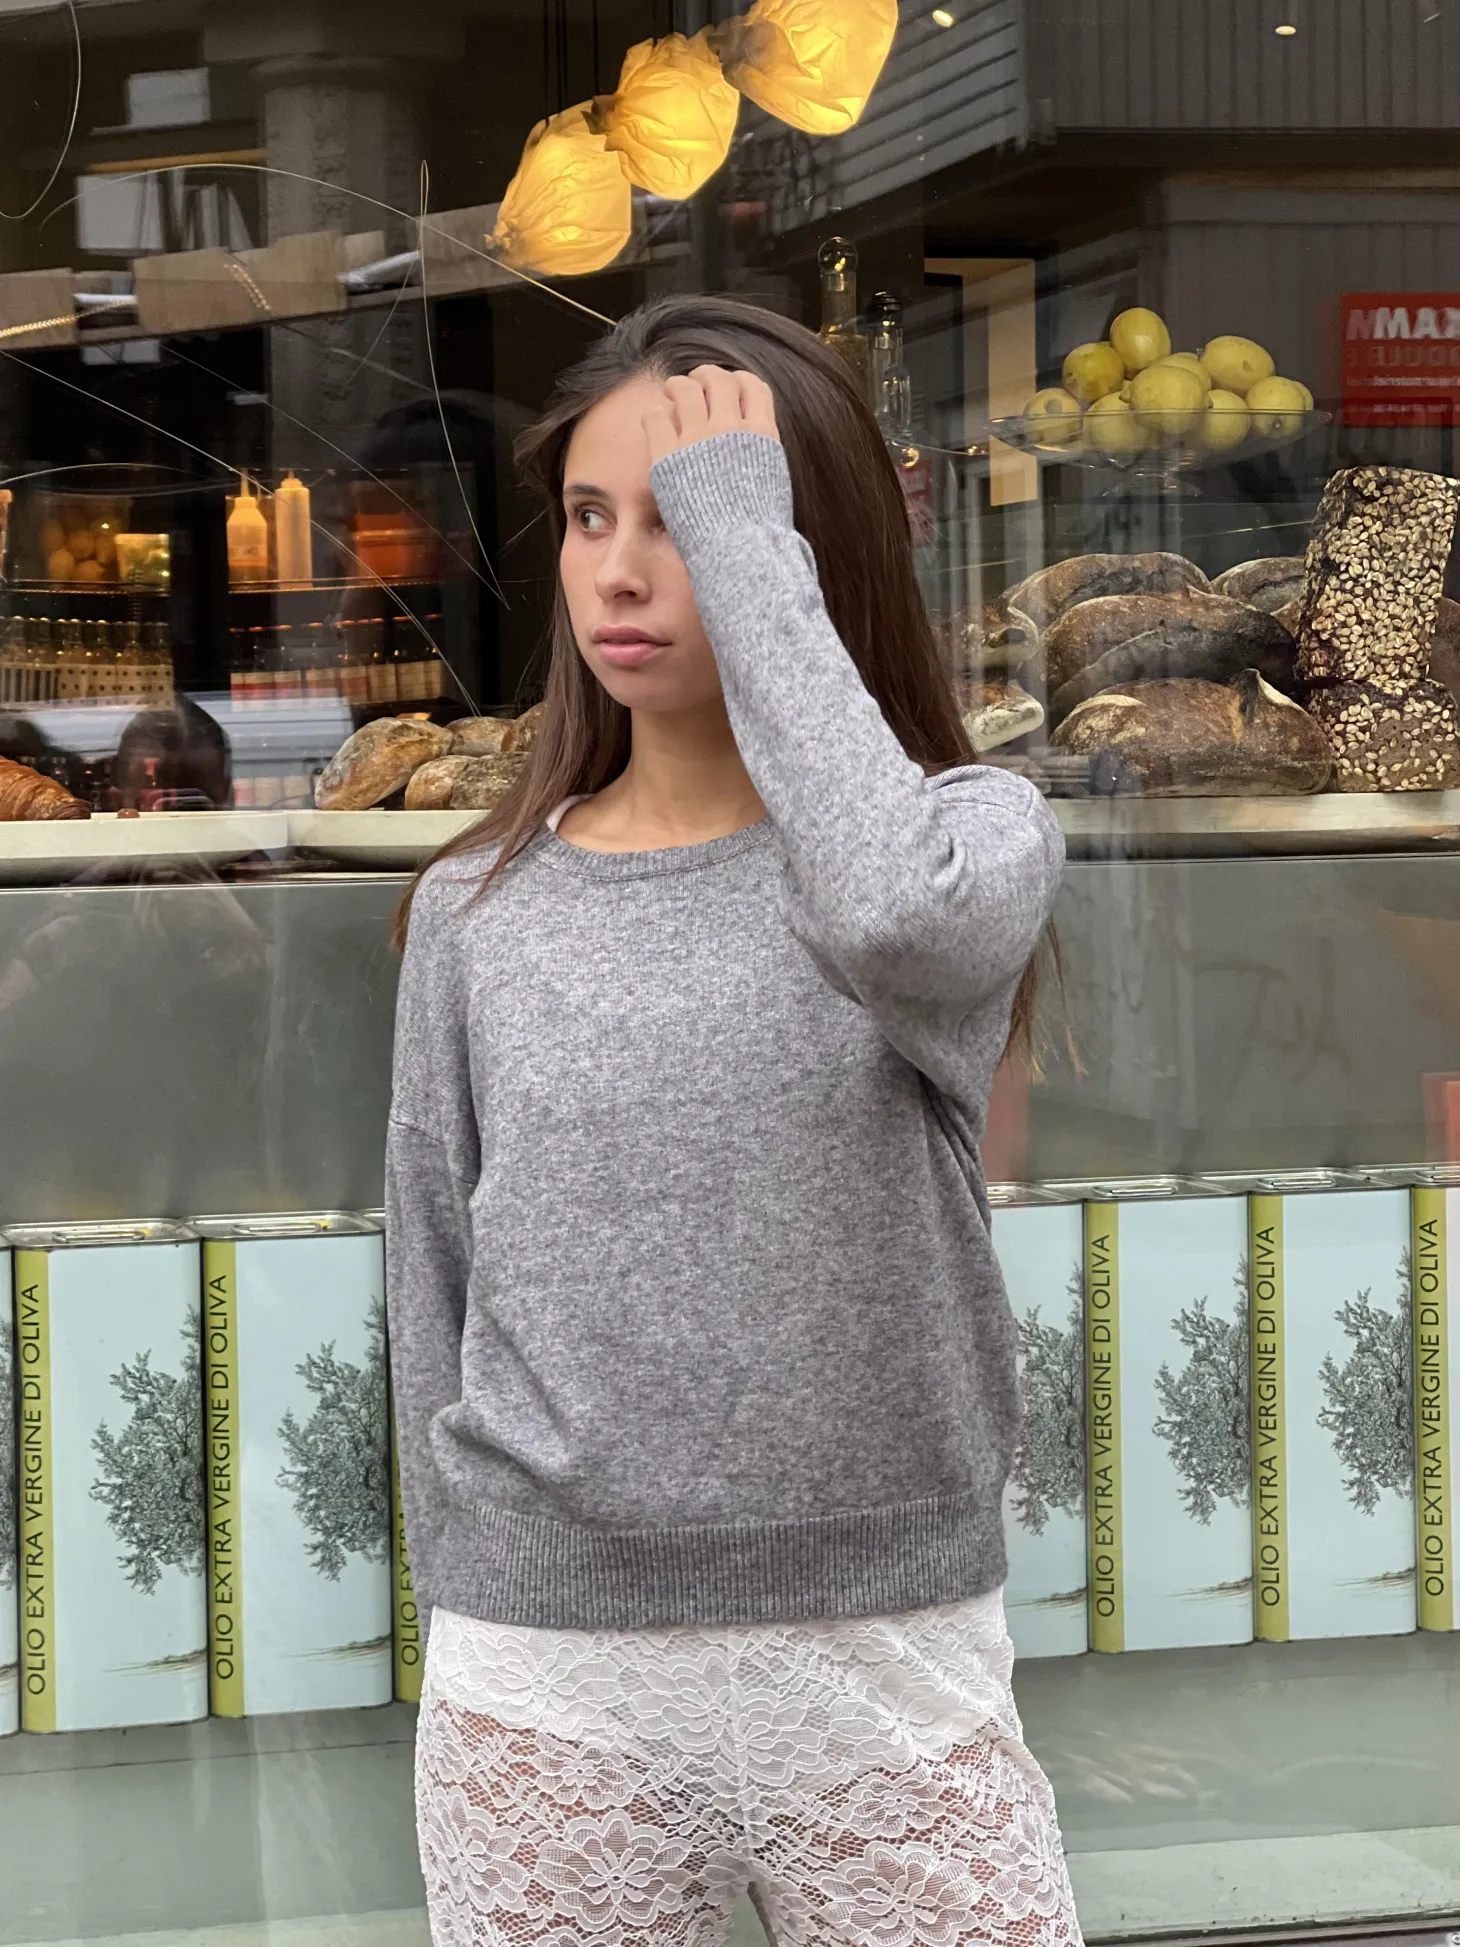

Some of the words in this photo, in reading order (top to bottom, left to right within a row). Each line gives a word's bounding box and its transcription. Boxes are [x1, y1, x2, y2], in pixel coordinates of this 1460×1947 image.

[1091, 1234, 1110, 1310] OLIVA
[1256, 1226, 1275, 1301] OLIVA
[1419, 1219, 1439, 1293] OLIVA
[21, 1284, 41, 1364] OLIVA
[209, 1275, 227, 1354] OLIVA
[1092, 1318, 1111, 1344] DI
[1257, 1310, 1275, 1334] DI
[1420, 1301, 1440, 1326] DI
[23, 1374, 41, 1400] DI
[210, 1363, 229, 1389] DI
[1092, 1352, 1112, 1457] VERGINE
[1258, 1343, 1277, 1447] VERGINE
[1421, 1334, 1442, 1438] VERGINE
[23, 1410, 44, 1523] VERGINE
[212, 1398, 232, 1510] VERGINE
[1423, 1446, 1443, 1526] EXTRA
[1094, 1465, 1114, 1546] EXTRA
[1259, 1455, 1279, 1536] EXTRA
[25, 1532, 45, 1619] EXTRA
[213, 1519, 233, 1604] EXTRA
[1095, 1555, 1115, 1617] OLIO
[1260, 1545, 1280, 1606] OLIO
[1425, 1535, 1444, 1596] OLIO
[26, 1628, 46, 1695] OLIO
[215, 1614, 234, 1680] OLIO
[400, 1601, 420, 1666] OLIO
